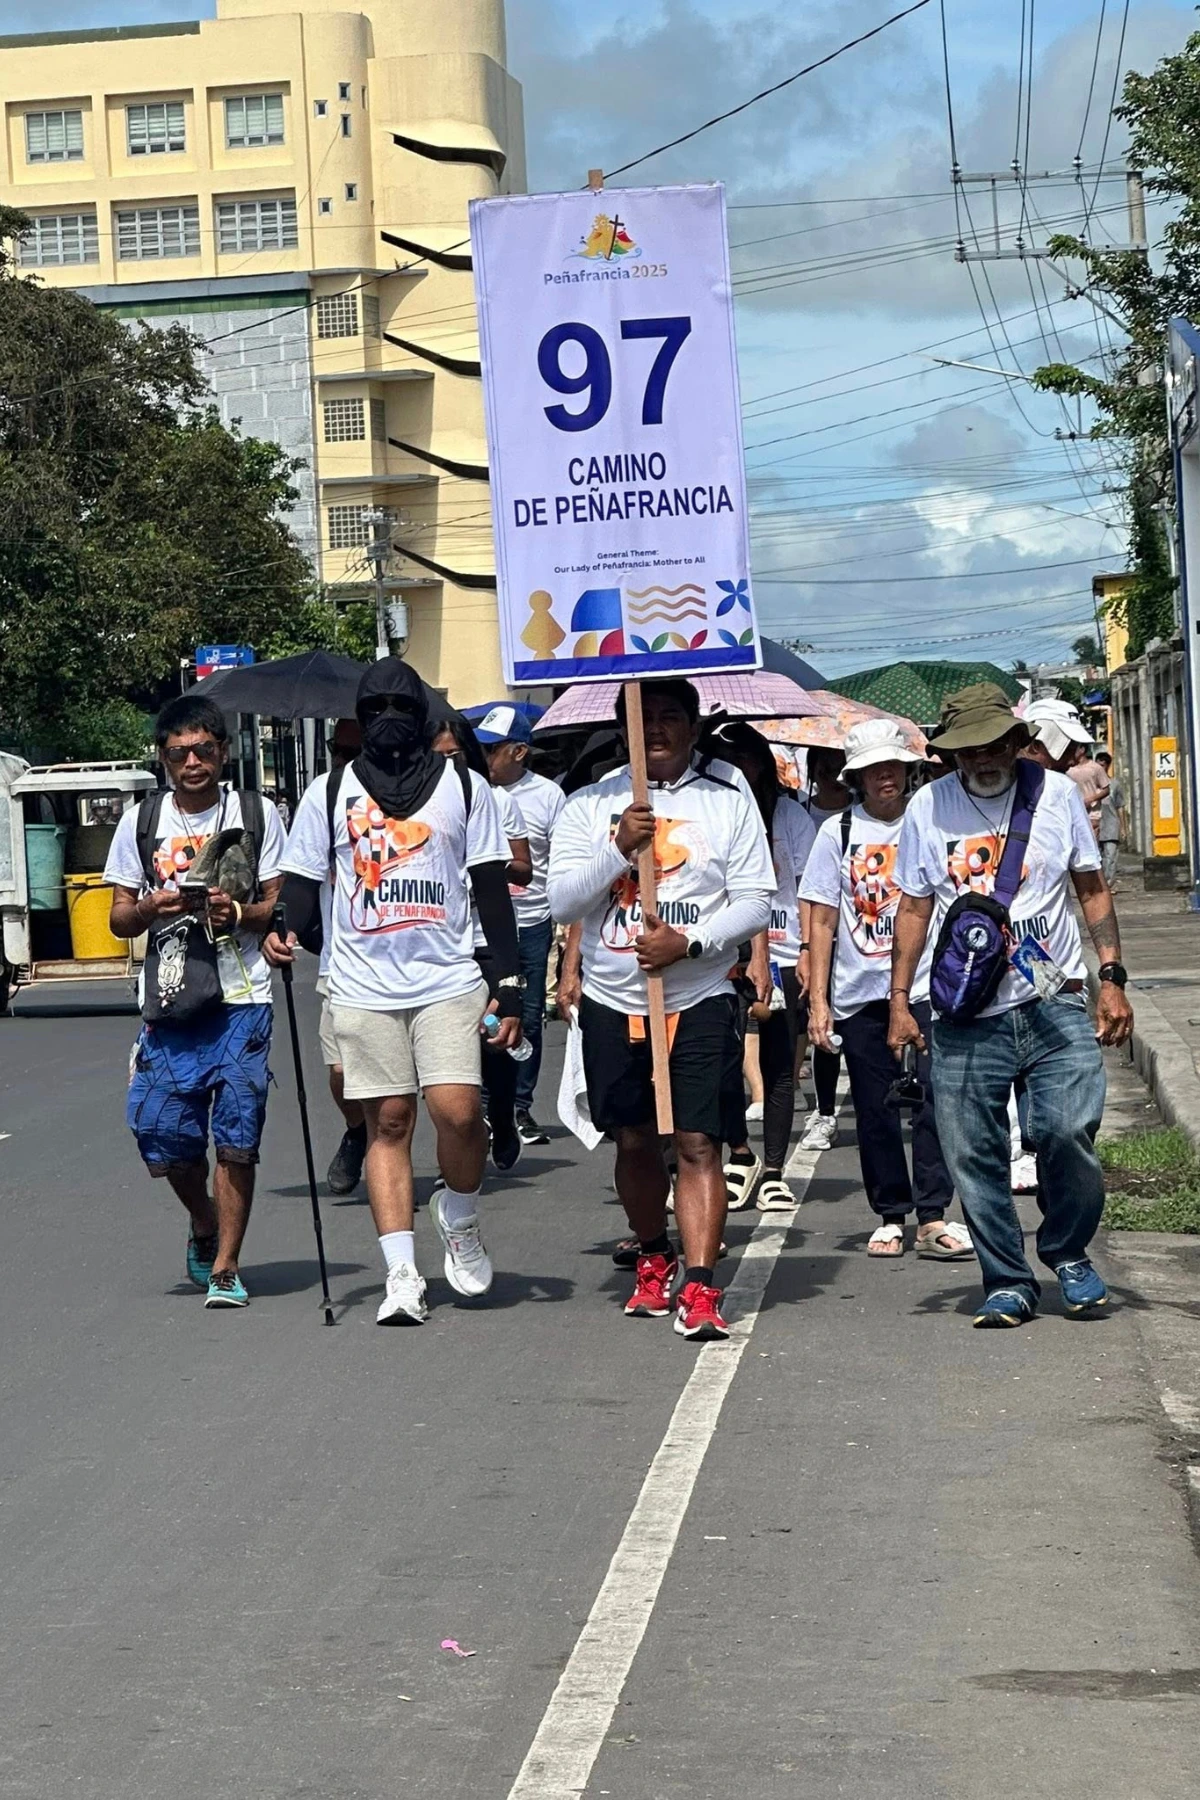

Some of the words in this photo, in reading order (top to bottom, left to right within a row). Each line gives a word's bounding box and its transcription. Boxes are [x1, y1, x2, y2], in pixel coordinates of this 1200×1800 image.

[543, 267, 630, 285] Peñafrancia
[632, 264, 668, 278] 2025
[537, 316, 692, 433] 97
[568, 452, 666, 486] CAMINO
[514, 497, 548, 527] DE
[555, 485, 734, 524] PEÑAFRANCIA
[571, 563, 590, 573] Lady
[592, 562, 601, 571] of
[653, 557, 683, 567] Mother
[694, 556, 706, 564] All
[597, 551, 629, 559] General
[630, 549, 660, 558] Theme:
[1160, 753, 1170, 765] K
[1155, 769, 1176, 778] 0440
[378, 878, 445, 906] CAMINO
[380, 904, 391, 917] DE
[630, 898, 700, 924] CMINO
